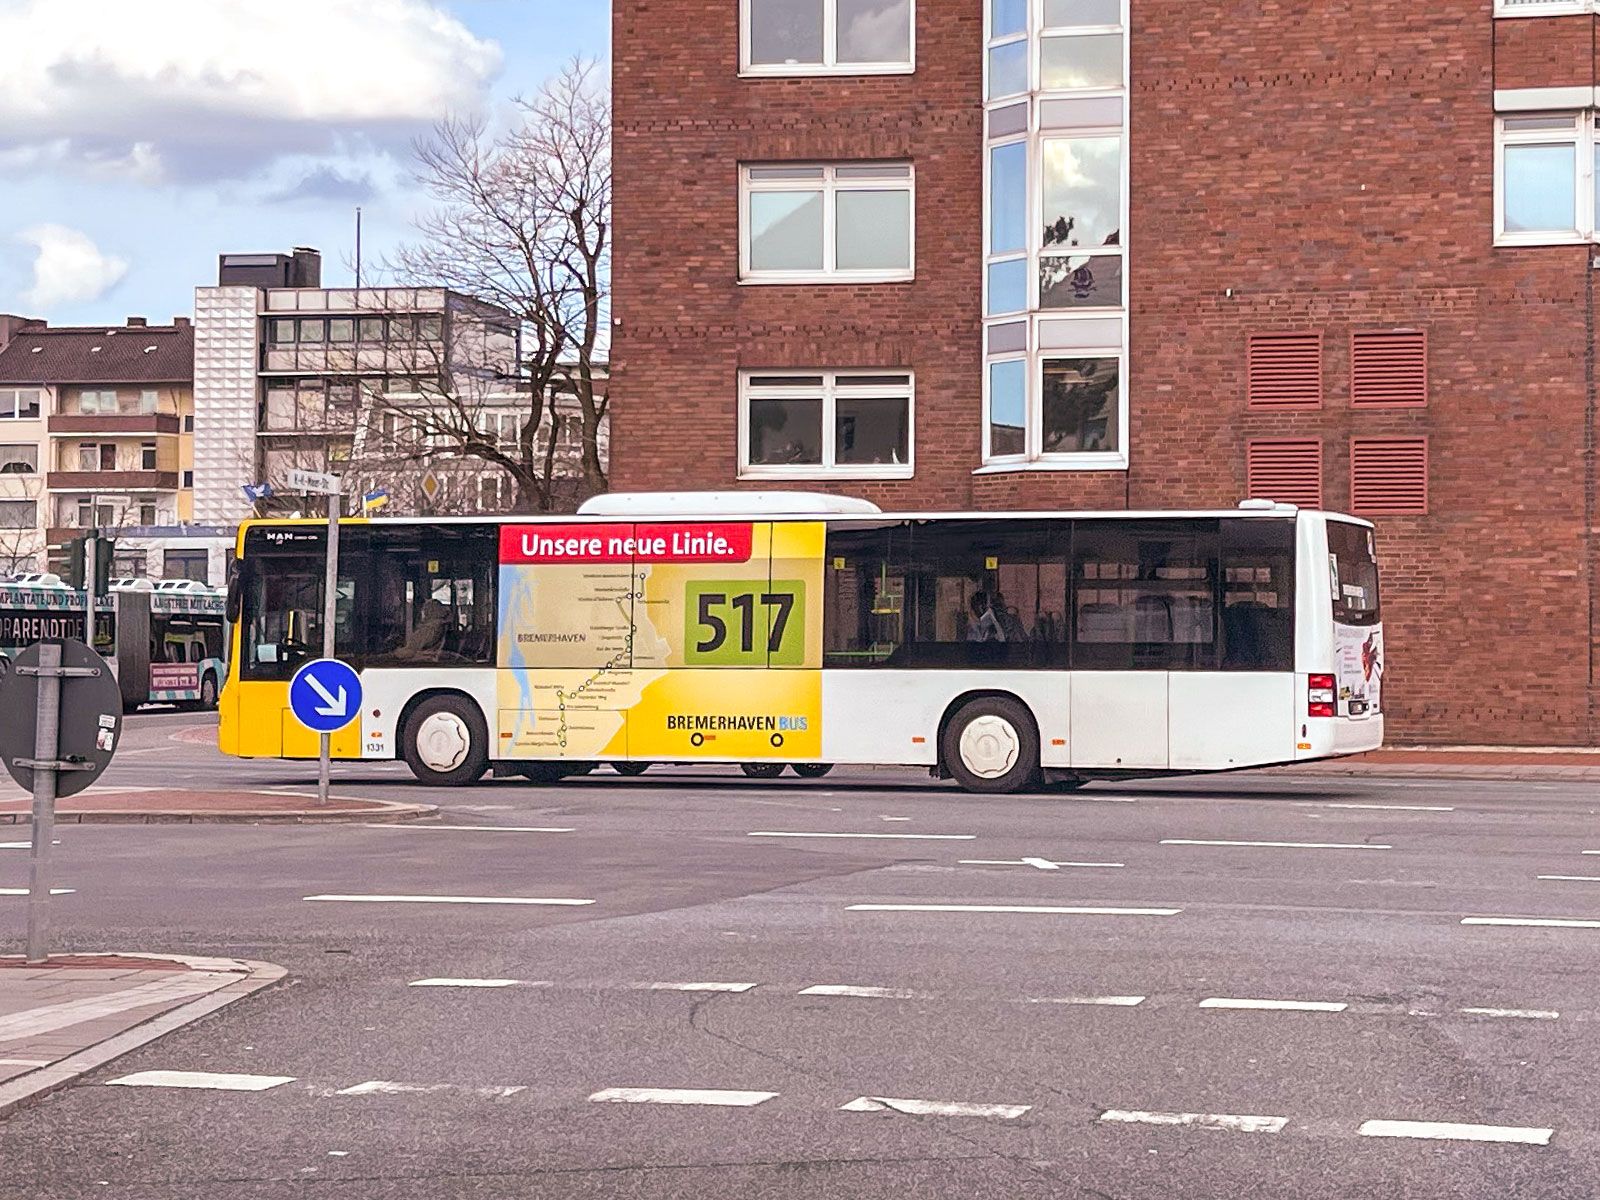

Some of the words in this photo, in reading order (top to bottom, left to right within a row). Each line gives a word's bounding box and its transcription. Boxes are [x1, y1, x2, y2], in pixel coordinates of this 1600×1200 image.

[266, 532, 293, 540] MAN
[521, 533, 602, 556] Unsere
[608, 537, 667, 555] neue
[672, 531, 735, 555] Linie.
[695, 593, 795, 653] 517
[517, 633, 587, 643] BREMERHAVEN
[667, 715, 776, 730] BREMERHAVEN
[778, 715, 808, 731] BUS
[366, 743, 385, 752] 1331
